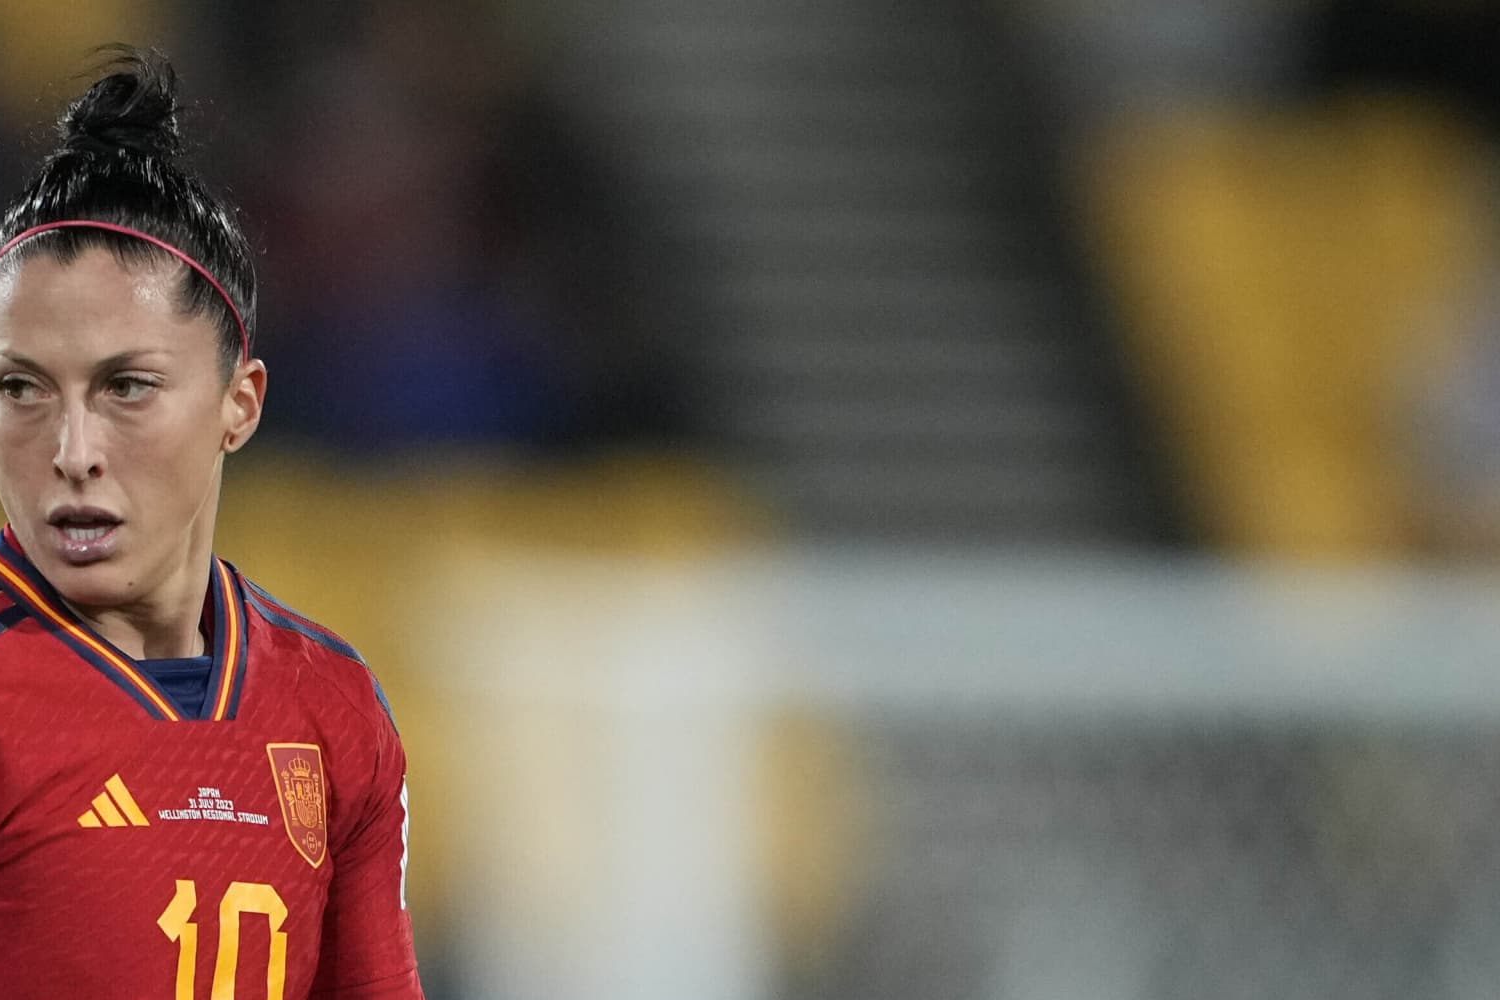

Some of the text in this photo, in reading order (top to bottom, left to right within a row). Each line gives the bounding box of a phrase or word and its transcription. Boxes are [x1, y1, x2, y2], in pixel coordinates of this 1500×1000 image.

[198, 787, 220, 798] JAPAN
[188, 798, 234, 810] 31 JULY 2023
[158, 809, 269, 825] WELLINGTON REGIONAL STADIUM
